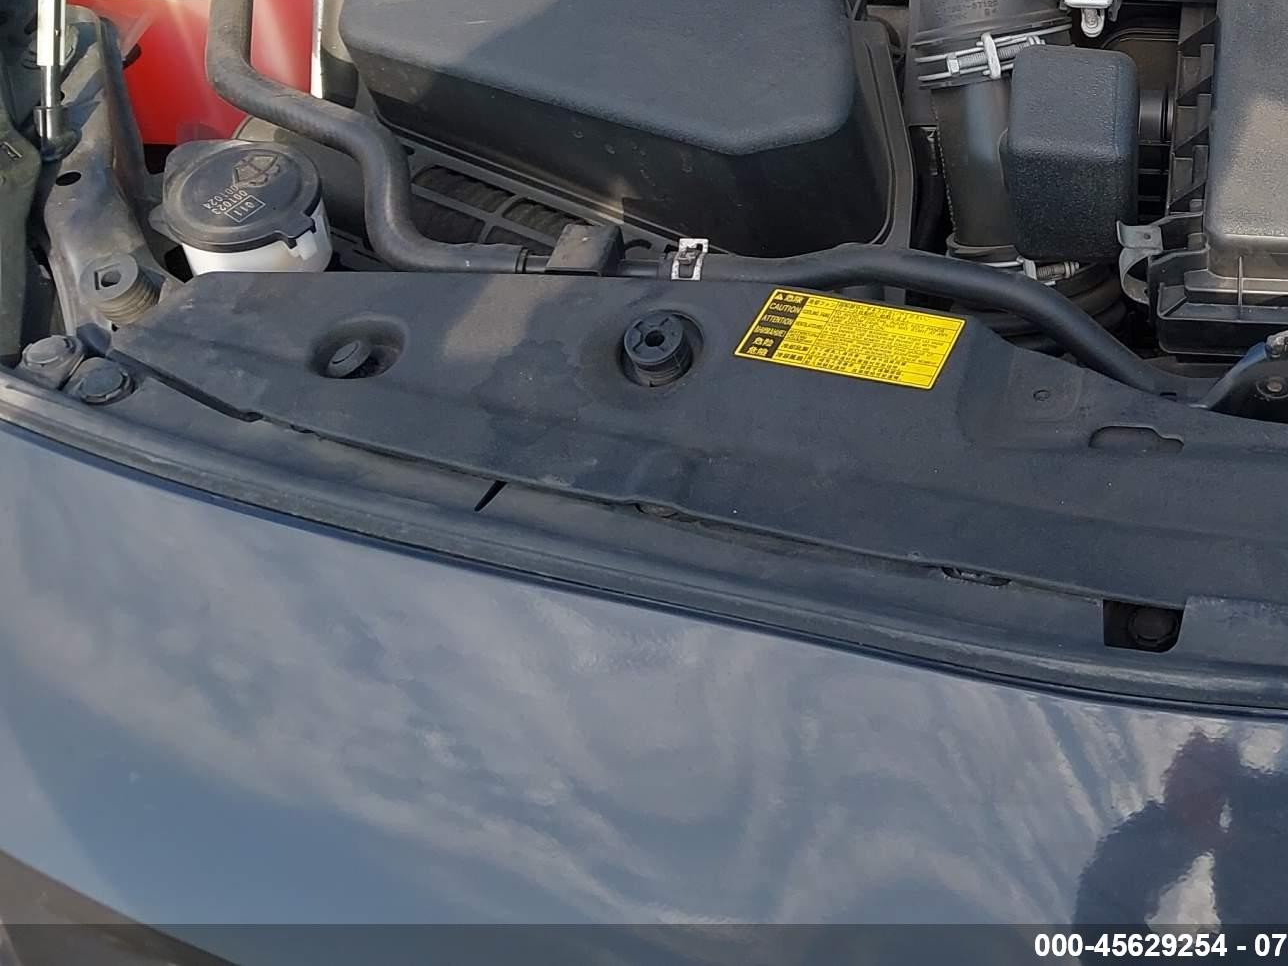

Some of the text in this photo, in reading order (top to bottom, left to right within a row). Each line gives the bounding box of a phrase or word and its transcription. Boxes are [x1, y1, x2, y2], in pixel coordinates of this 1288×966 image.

[211, 190, 249, 215] 001023
[769, 302, 801, 314] CAUTION
[761, 314, 794, 326] ATTENTION
